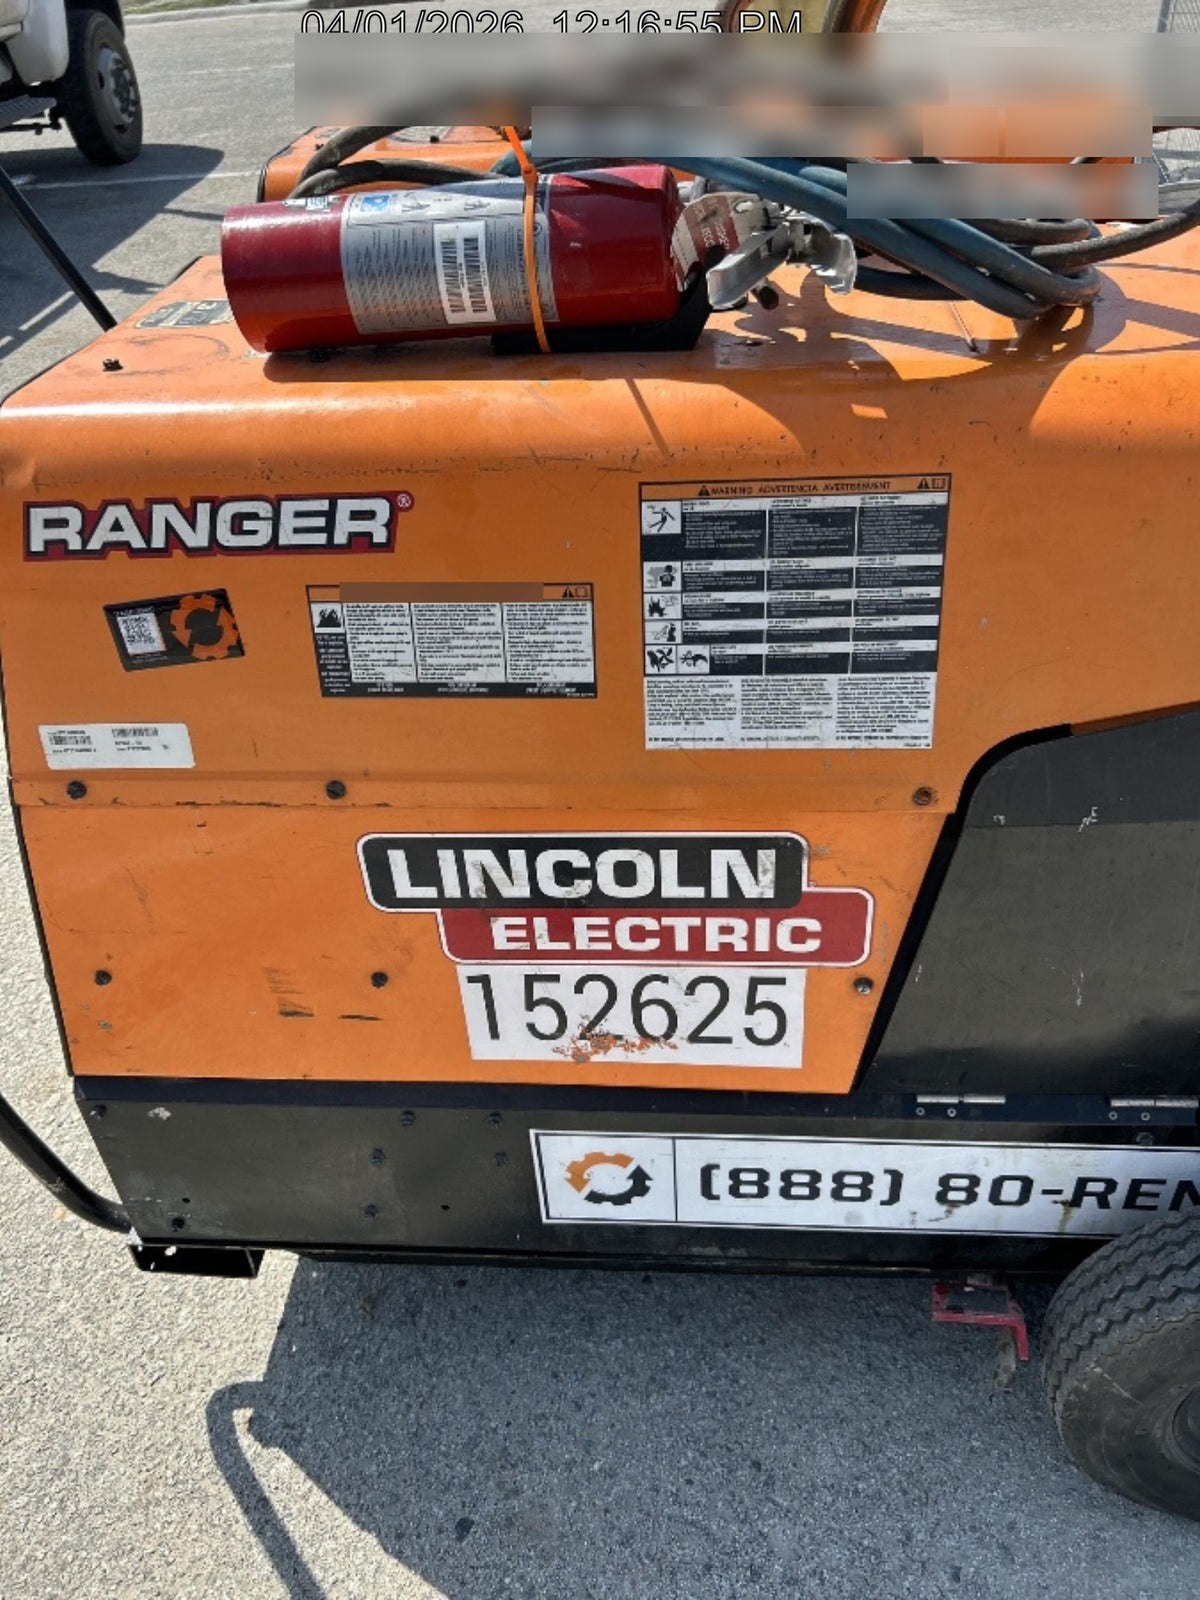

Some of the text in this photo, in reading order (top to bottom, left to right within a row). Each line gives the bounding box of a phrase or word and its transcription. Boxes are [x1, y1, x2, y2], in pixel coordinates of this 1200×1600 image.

[29, 497, 391, 552] RANGER
[387, 848, 776, 900] LINCOLN
[491, 916, 823, 953] ELECTRIC
[466, 972, 788, 1047] 152625
[700, 1163, 904, 1207] (888)
